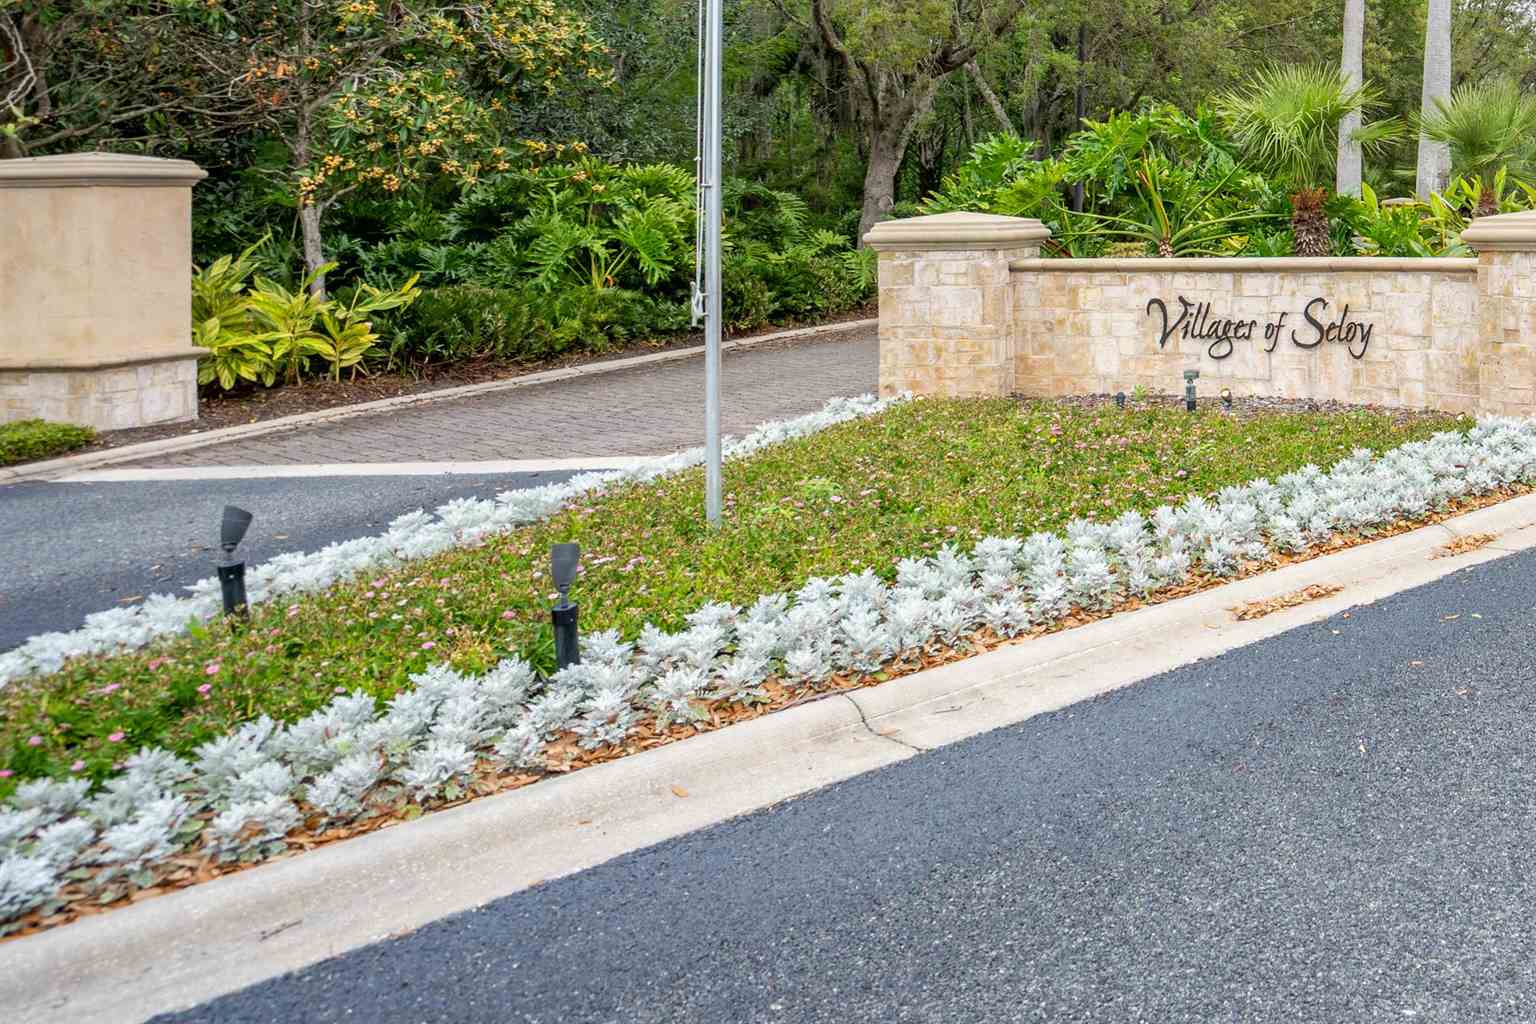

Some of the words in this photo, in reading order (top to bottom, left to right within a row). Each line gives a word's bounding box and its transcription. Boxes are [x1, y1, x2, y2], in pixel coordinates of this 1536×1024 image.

[1147, 296, 1257, 360] Villages
[1263, 312, 1288, 353] of
[1292, 297, 1374, 360] Seloy
